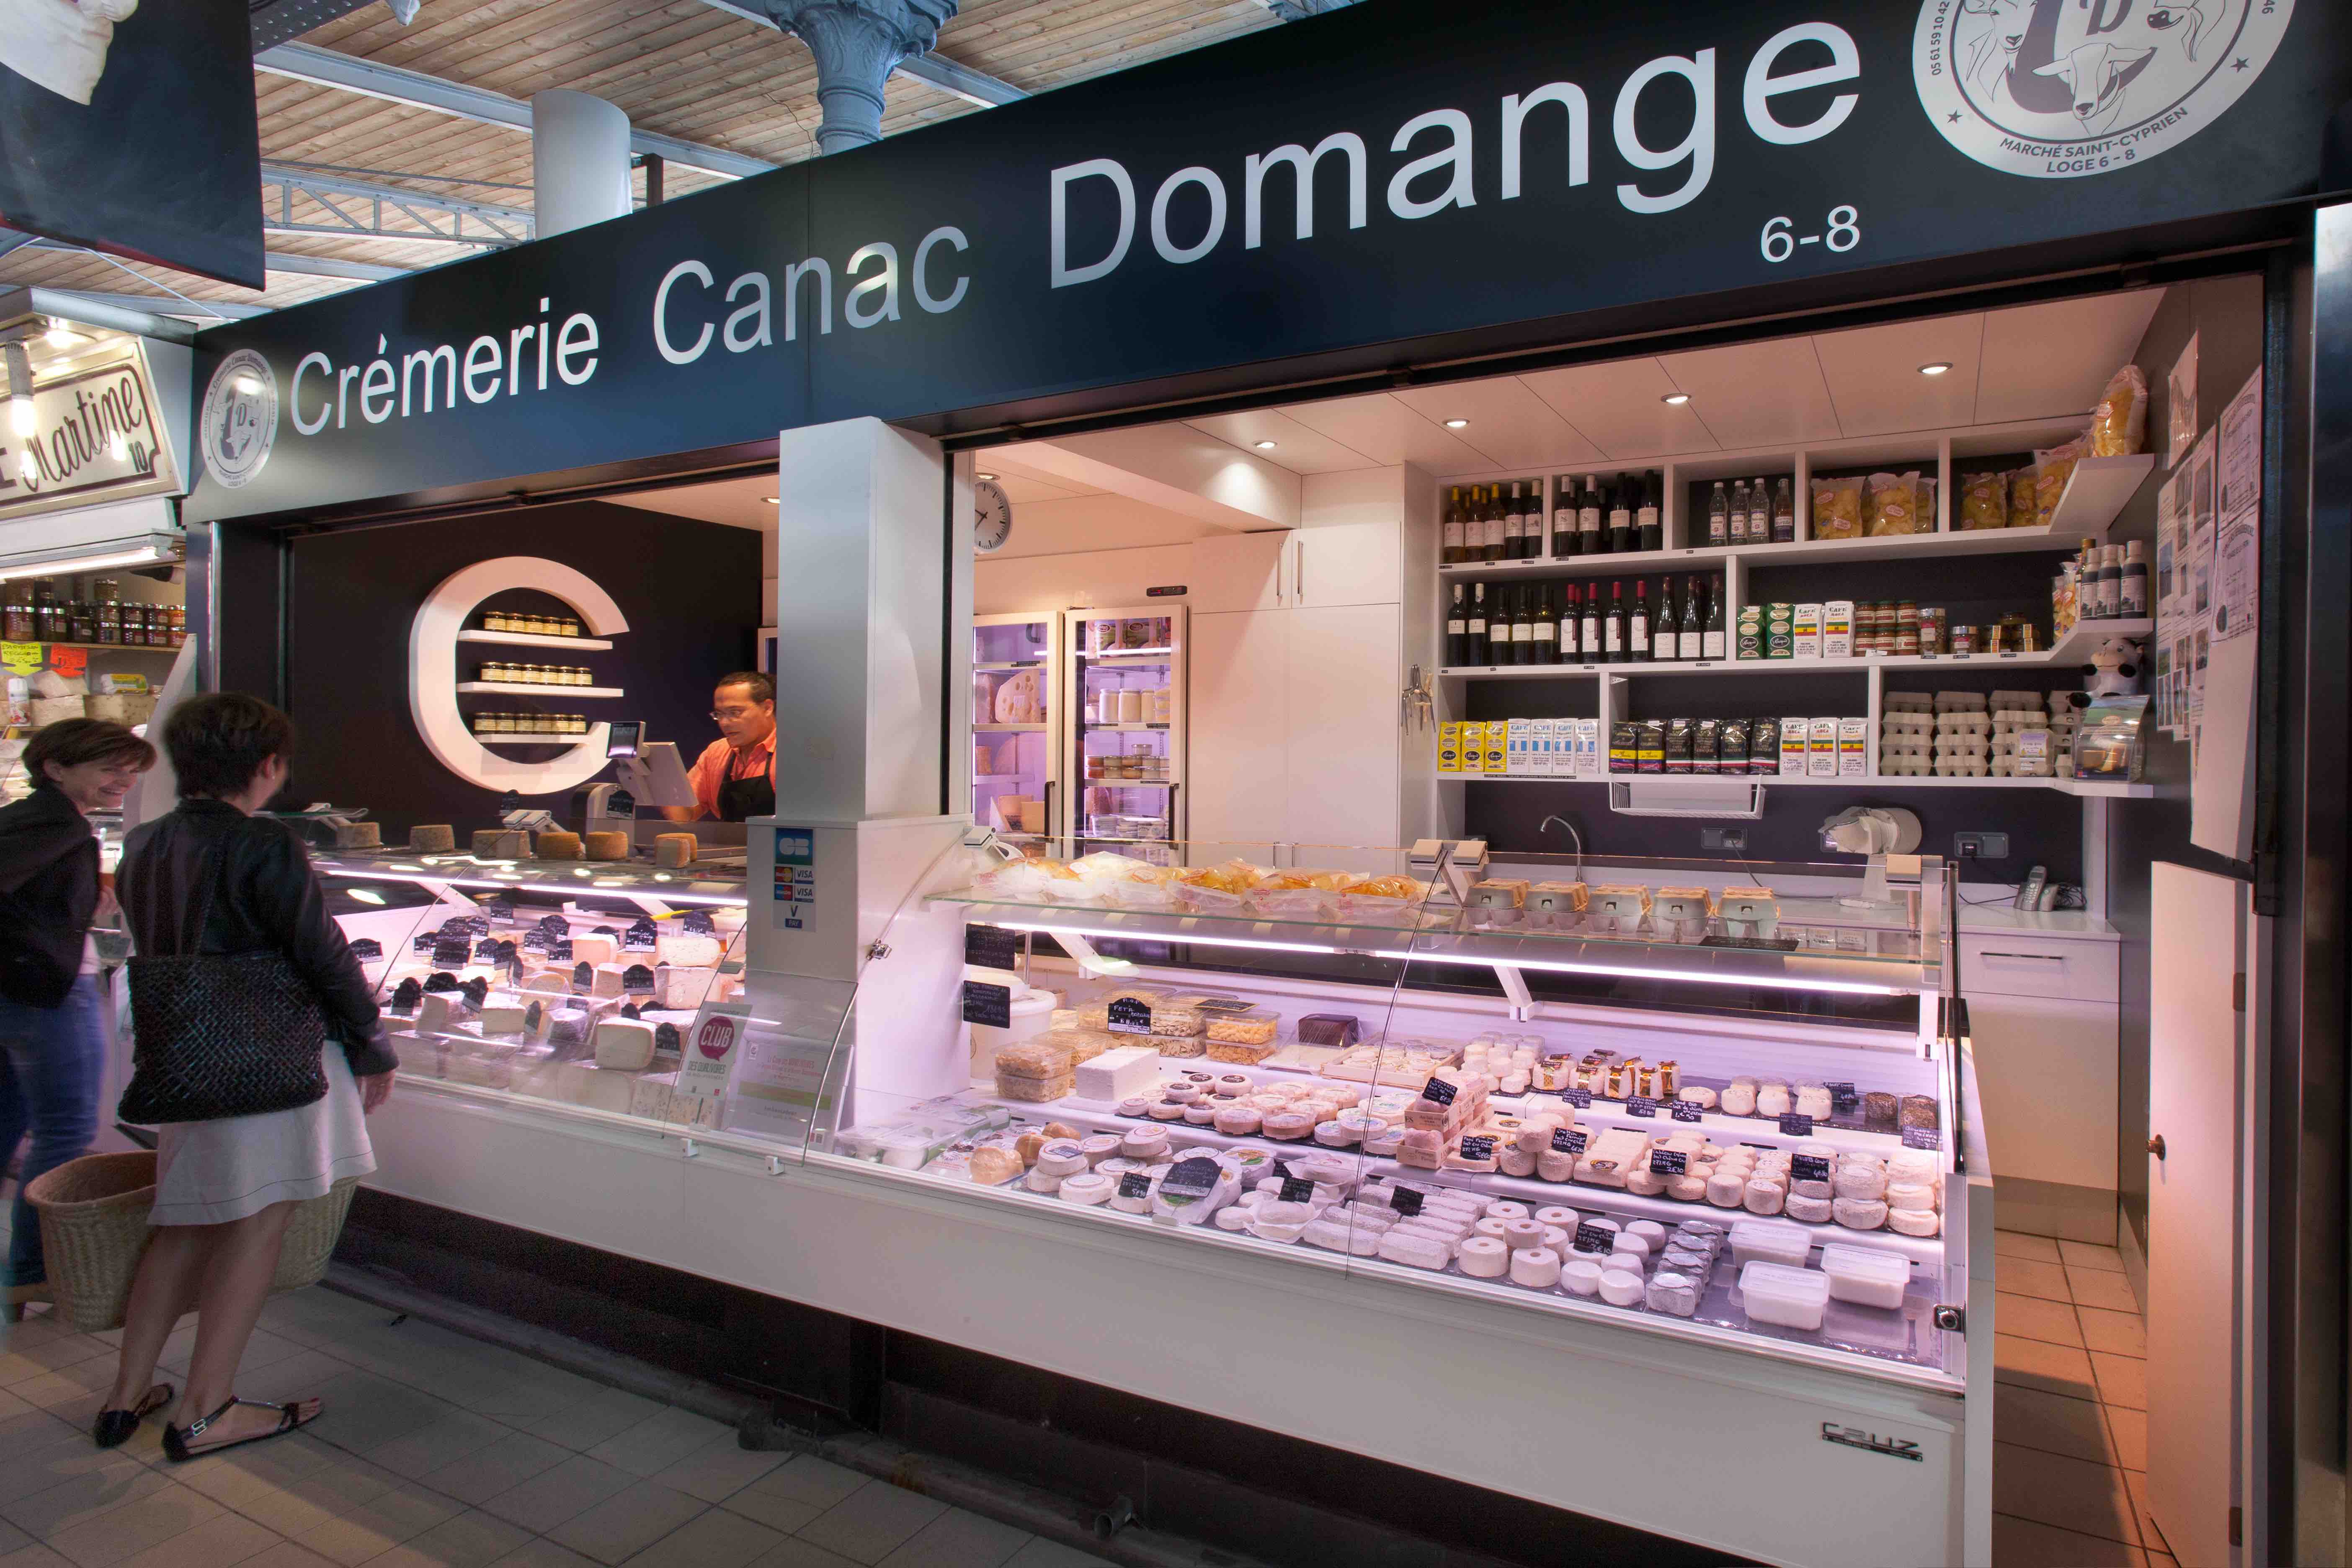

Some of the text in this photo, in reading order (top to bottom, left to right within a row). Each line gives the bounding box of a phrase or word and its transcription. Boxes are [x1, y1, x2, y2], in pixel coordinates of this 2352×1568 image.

[1930, 1, 1950, 76] 05 61 59 10 42
[2000, 106, 2189, 157] MARCHÉ SAINT-CYPRIEN
[2045, 159, 2094, 173] LOGE
[2099, 156, 2109, 167] 6
[2125, 149, 2136, 160] 8
[291, 21, 1860, 436] Crémerie Canac Domange
[1761, 205, 1860, 263] 6-8
[129, 440, 149, 473] 10
[779, 837, 810, 856] CB
[797, 869, 813, 879] VISA
[797, 888, 813, 897] VISA
[701, 1025, 733, 1047] CLUB
